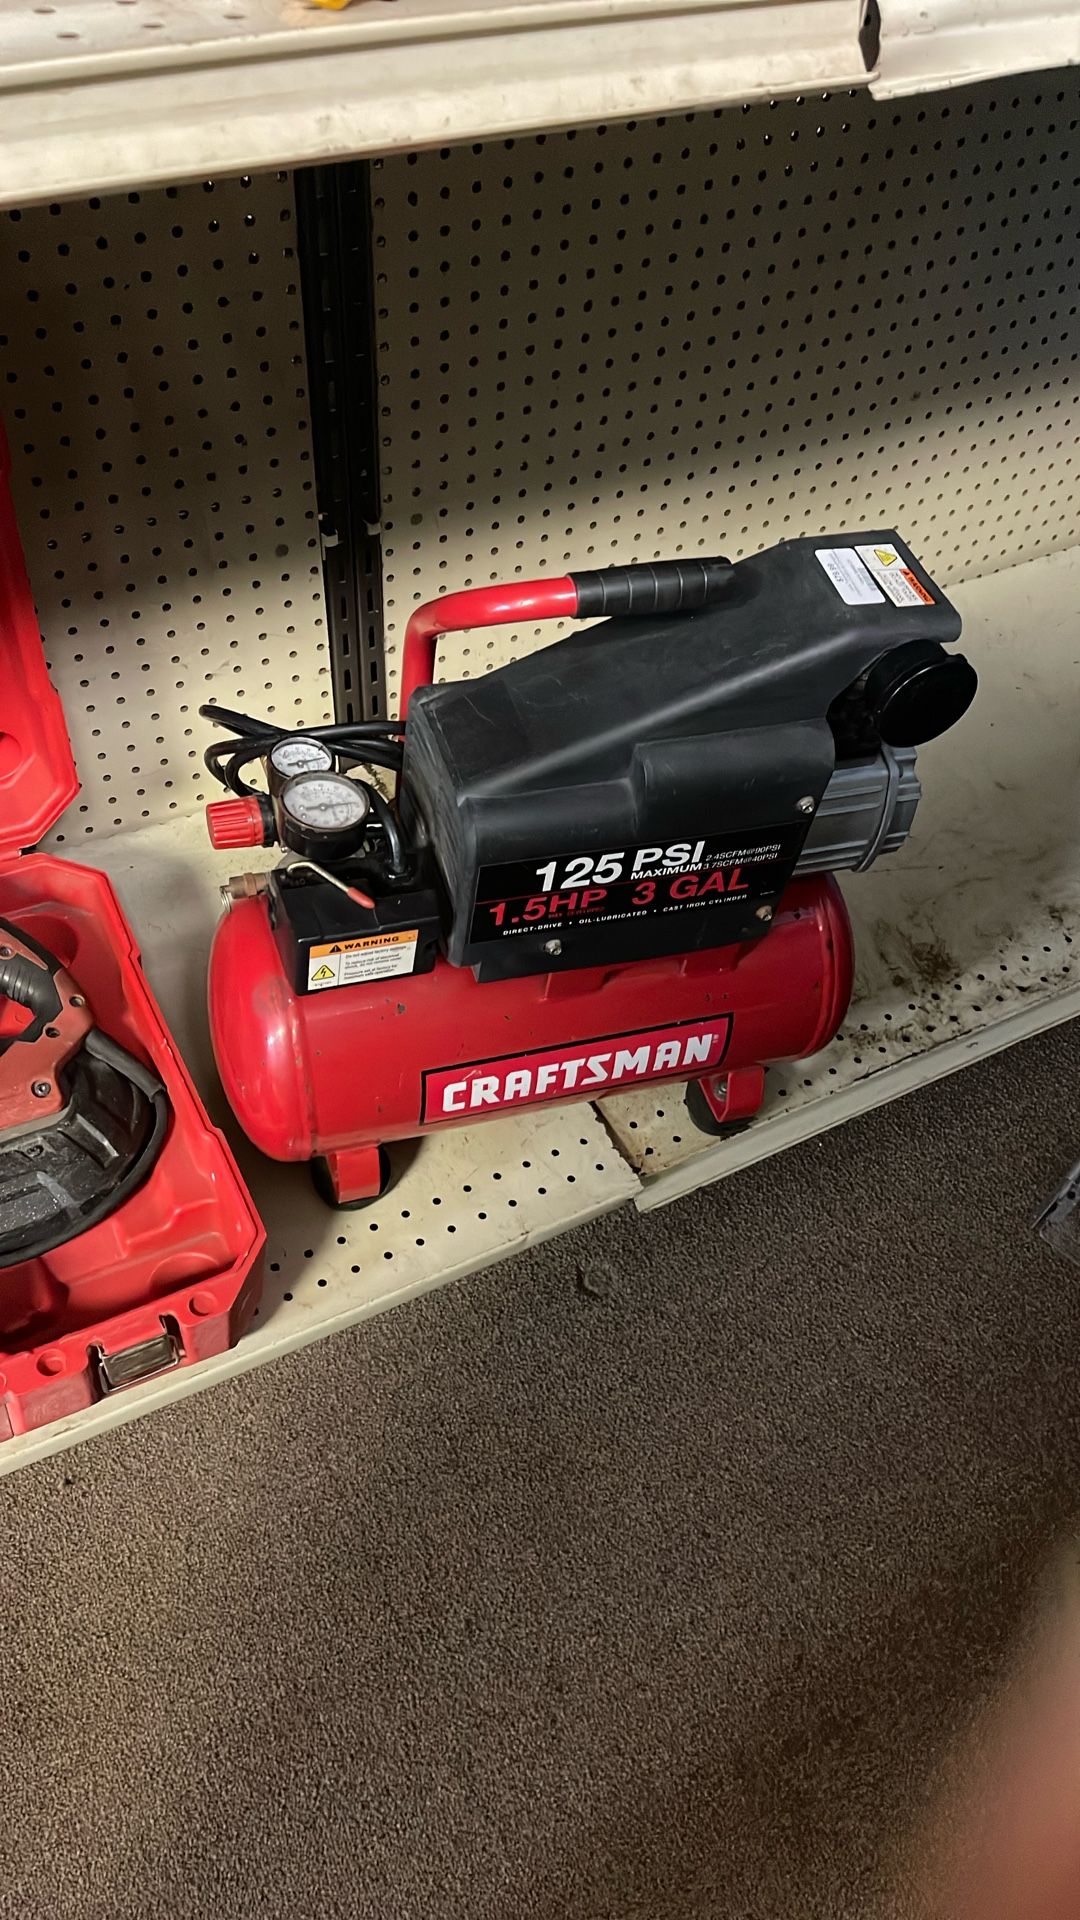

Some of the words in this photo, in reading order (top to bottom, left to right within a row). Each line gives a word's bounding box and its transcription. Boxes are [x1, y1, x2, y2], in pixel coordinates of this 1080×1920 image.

[536, 852, 625, 893] 125
[632, 841, 705, 872] PSI
[631, 863, 702, 880] MAXIMUM
[489, 889, 608, 926] 1.5HP
[632, 881, 656, 905] 3
[670, 868, 749, 899] GAL
[502, 922, 563, 936] DIRECT-DRIVE
[578, 910, 648, 925] OIL-LUBRICATED
[662, 904, 684, 913] CAST
[686, 901, 706, 909] IRON
[708, 894, 748, 906] CYLINDER
[344, 936, 399, 949] WARNING
[441, 1033, 713, 1112] CRAFTSMAN
